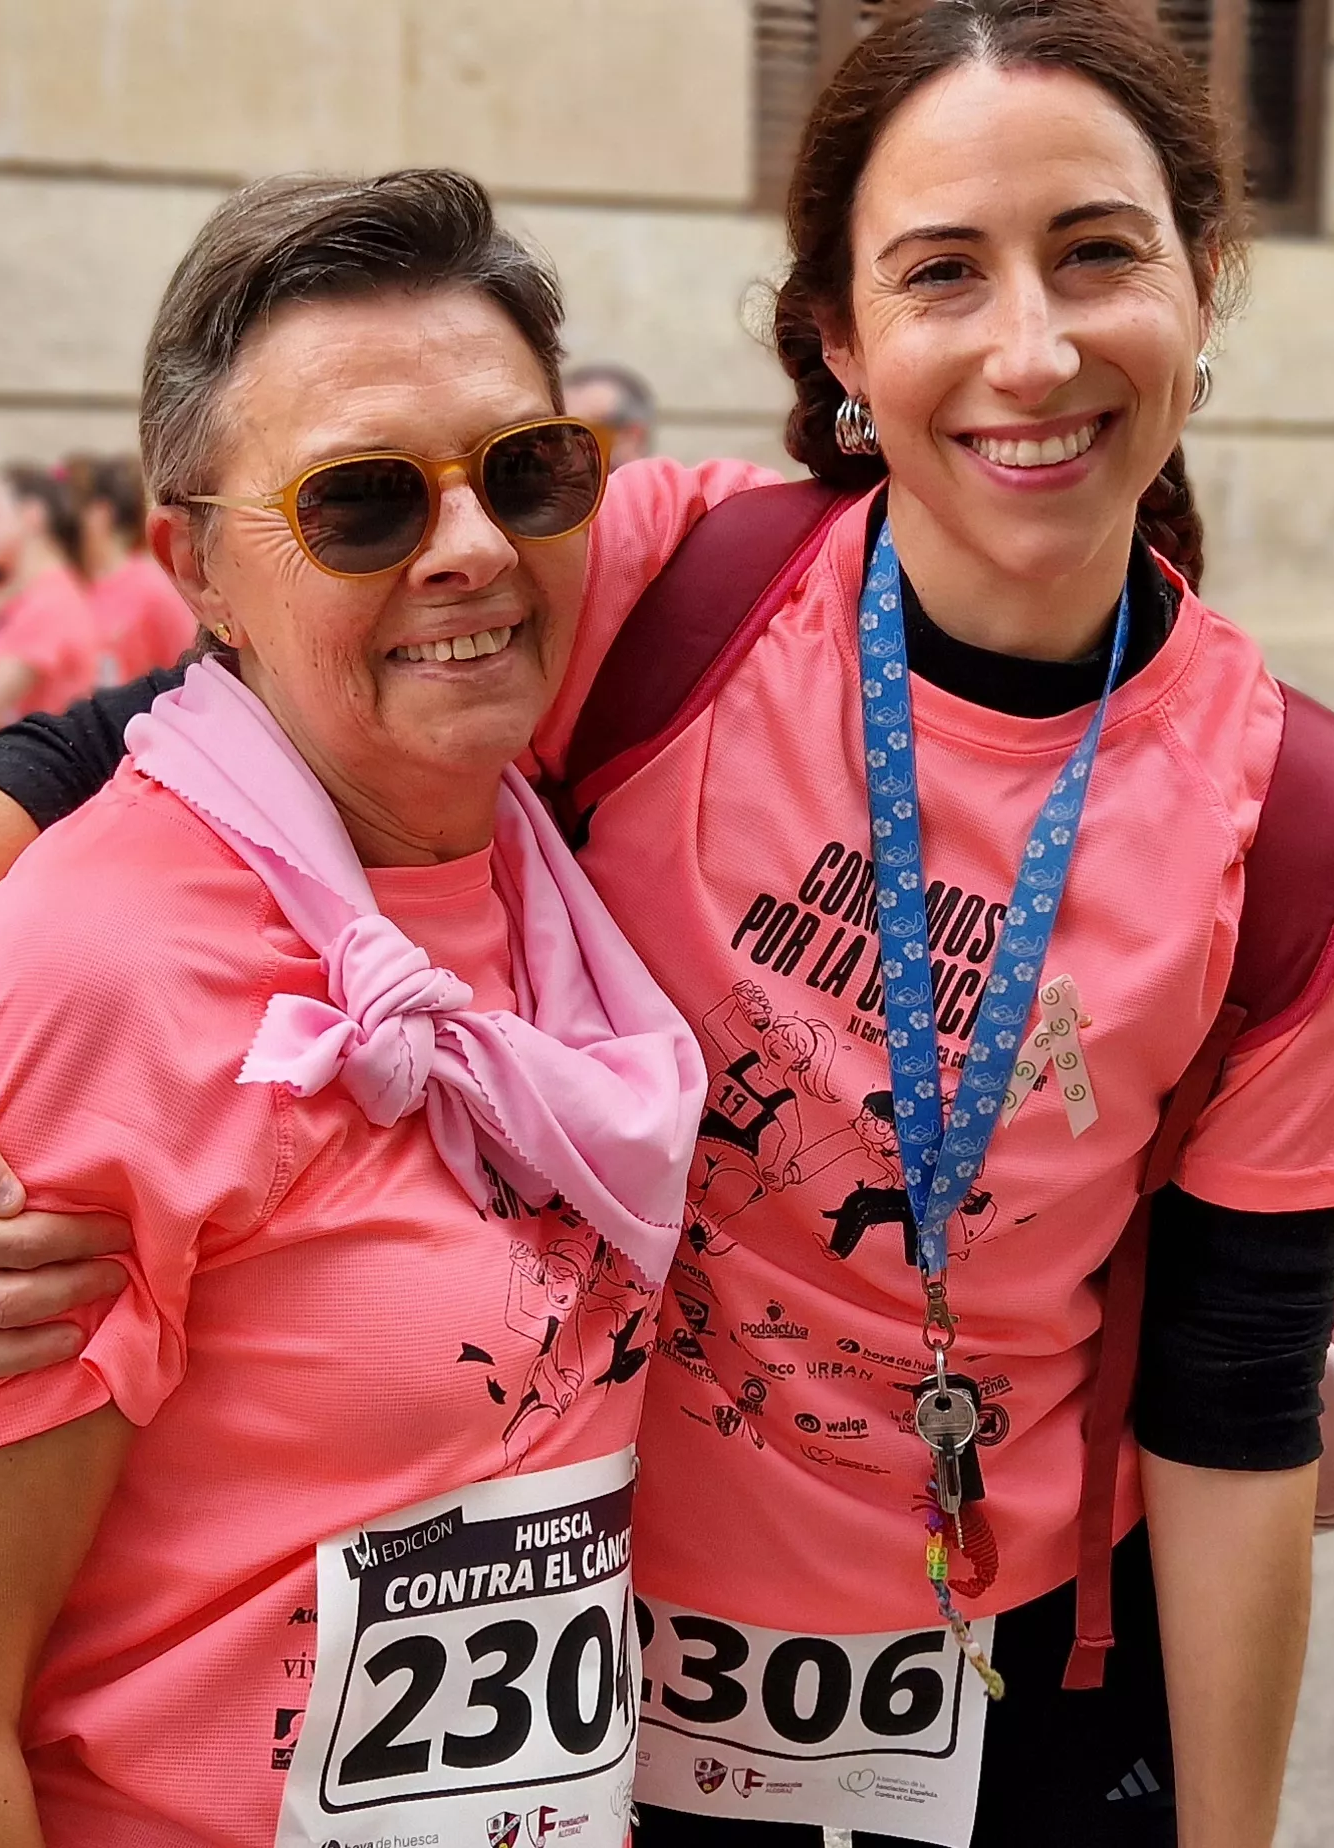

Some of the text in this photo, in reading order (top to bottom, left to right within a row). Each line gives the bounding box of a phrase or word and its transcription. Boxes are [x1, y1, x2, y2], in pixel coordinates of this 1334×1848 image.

[730, 893, 821, 977] POR
[805, 926, 868, 998] LA
[846, 1014, 888, 1050] XI Carr
[718, 1083, 749, 1119] 19
[740, 1319, 809, 1336] podoactiva
[806, 1361, 873, 1382] URBAN
[863, 1347, 895, 1364] hoya
[896, 1356, 912, 1368] de
[382, 1518, 454, 1564] EDICIÓN
[515, 1510, 594, 1552] HUESCA
[384, 1524, 633, 1615] CONTRA EL CÁNCE
[337, 1583, 633, 1787] 2304
[393, 1834, 439, 1848] huesca
